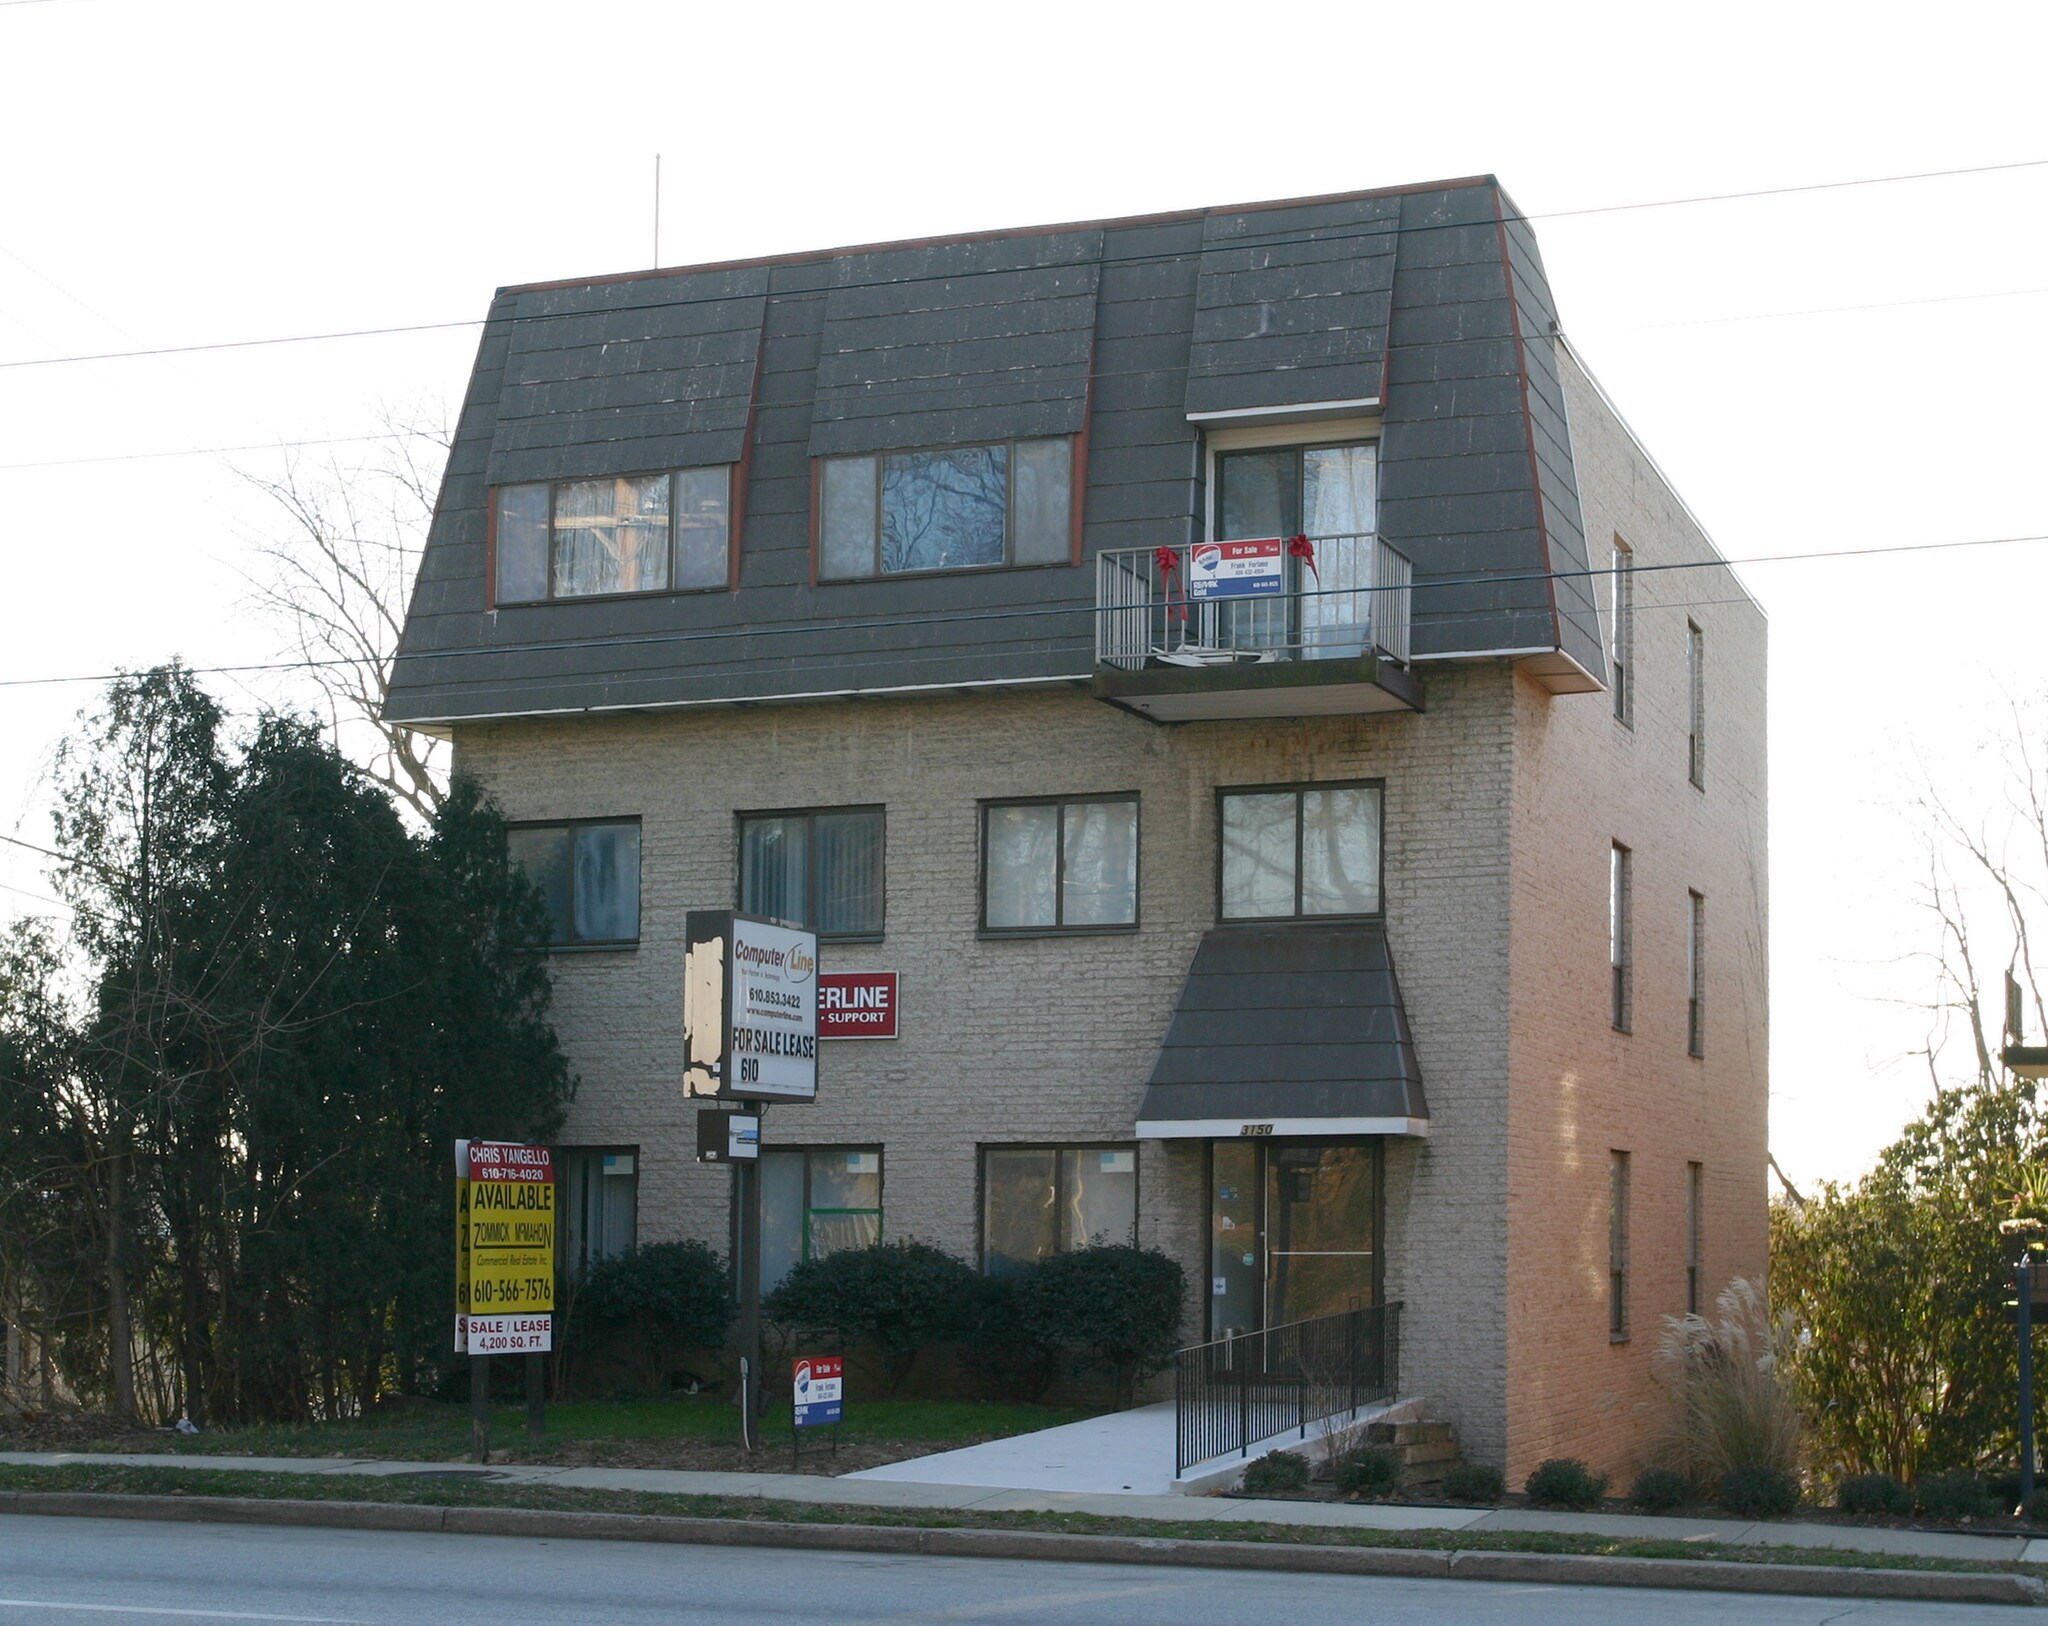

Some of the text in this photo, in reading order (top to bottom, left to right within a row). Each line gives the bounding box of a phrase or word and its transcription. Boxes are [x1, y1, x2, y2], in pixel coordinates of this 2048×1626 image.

[1232, 547, 1242, 555] For
[1244, 546, 1258, 554] Sale
[735, 939, 814, 973] Computer Line
[749, 987, 800, 1008] 610.853.3422
[828, 1012, 886, 1023] SUPPORT
[733, 1026, 814, 1059] FOR SALE LEASE
[741, 1058, 759, 1082] 610
[1241, 1124, 1273, 1135] 3150
[470, 1147, 549, 1165] CHRIS YANGELLO
[482, 1167, 544, 1180] 610-716-4020
[474, 1184, 551, 1210] AVAILABLE
[474, 1278, 550, 1303] 610-566-7576
[470, 1321, 503, 1334] SALE
[506, 1321, 511, 1333] /
[514, 1320, 550, 1332] LEASE
[480, 1337, 507, 1351] 4,200
[510, 1336, 526, 1348] SQ.
[529, 1336, 542, 1347] FT.
